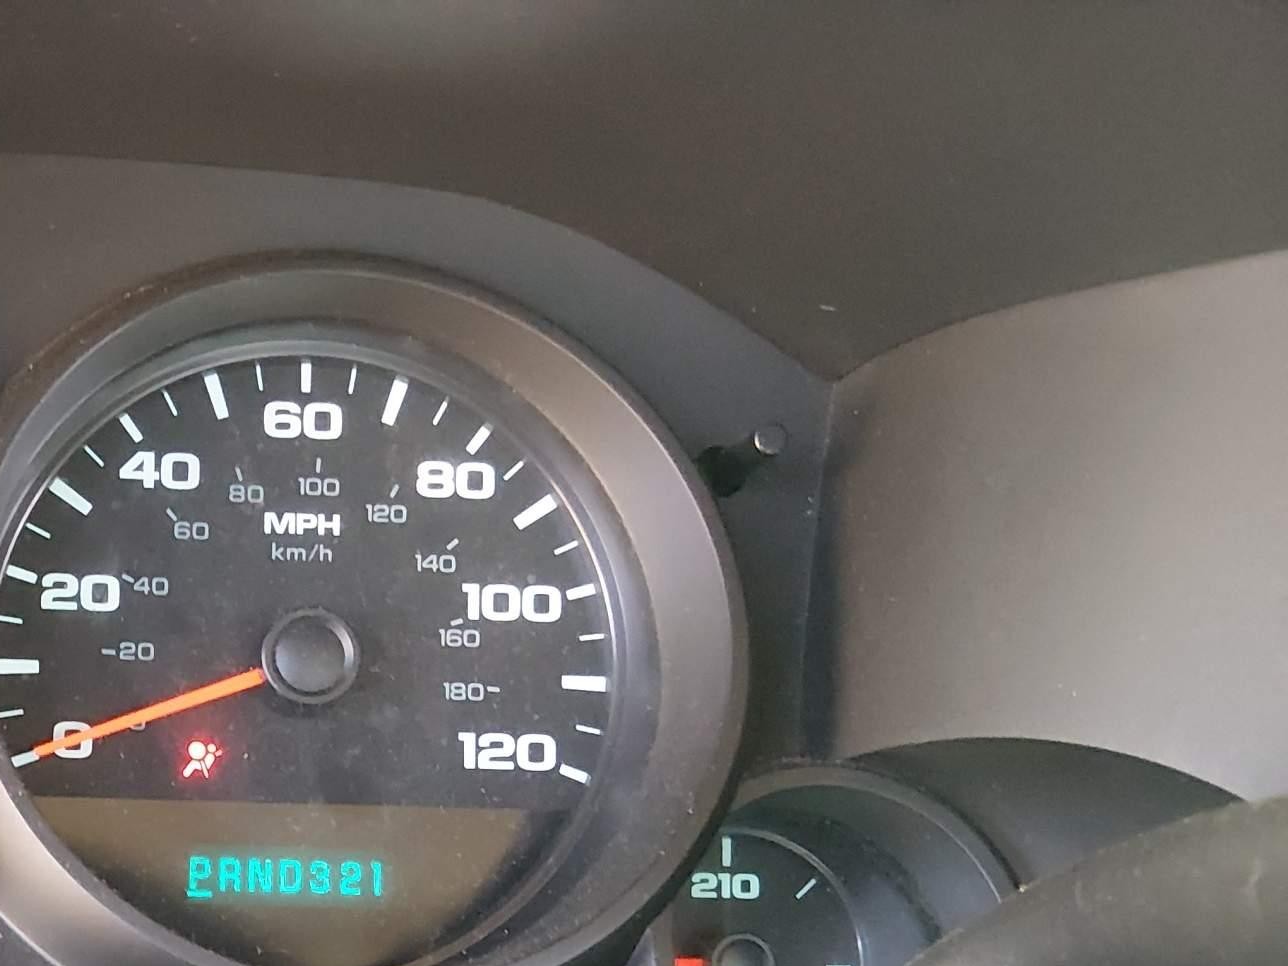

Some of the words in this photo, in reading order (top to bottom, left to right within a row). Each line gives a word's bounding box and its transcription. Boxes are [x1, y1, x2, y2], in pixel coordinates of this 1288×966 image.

[263, 400, 343, 440] 60
[119, 450, 201, 490] 40
[415, 460, 496, 500] 80
[228, 484, 265, 505] 80
[297, 477, 340, 497] 100
[263, 511, 341, 537] MPH
[365, 503, 408, 524] 120
[173, 520, 210, 541] 60
[271, 542, 333, 563] km/h
[414, 553, 457, 573] 140
[40, 572, 121, 612] 20
[133, 575, 169, 596] 40
[461, 583, 562, 623] 100
[438, 628, 481, 648] 160
[119, 641, 155, 662] 20
[443, 681, 484, 702] 180
[53, 721, 93, 758] 0
[458, 732, 557, 771] 120
[691, 872, 760, 900] 210
